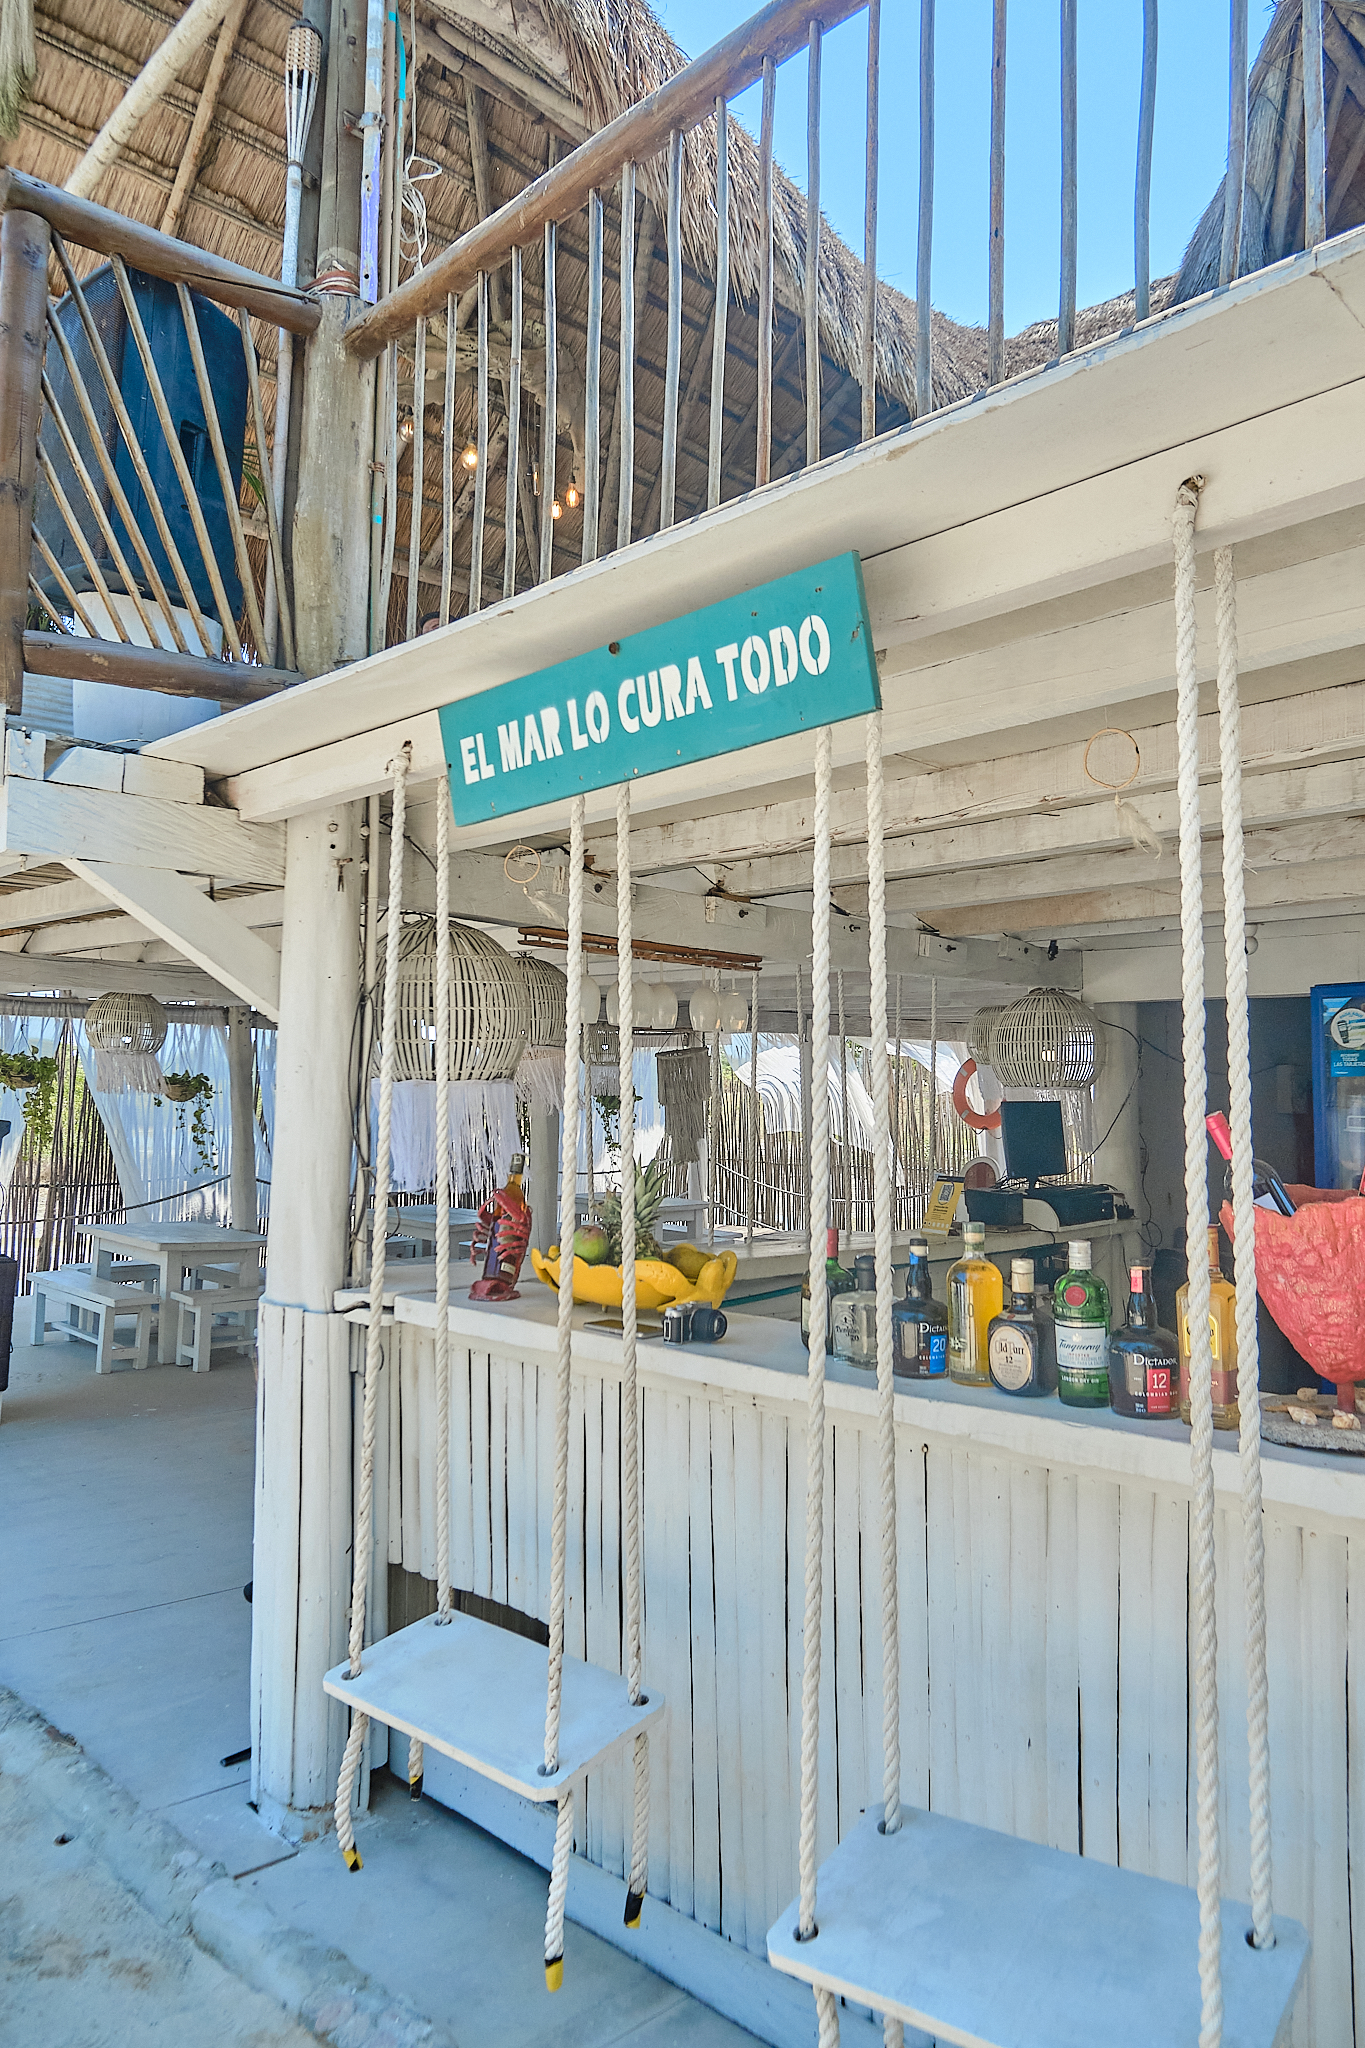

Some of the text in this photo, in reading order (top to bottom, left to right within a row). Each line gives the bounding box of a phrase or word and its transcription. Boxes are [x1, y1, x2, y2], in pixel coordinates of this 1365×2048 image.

[460, 614, 831, 785] EL MAR LO CURA TODO
[932, 1338, 946, 1353] 20
[1059, 1338, 1101, 1353] Tanqueray
[1005, 1355, 1014, 1364] 12
[1152, 1372, 1167, 1389] 12
